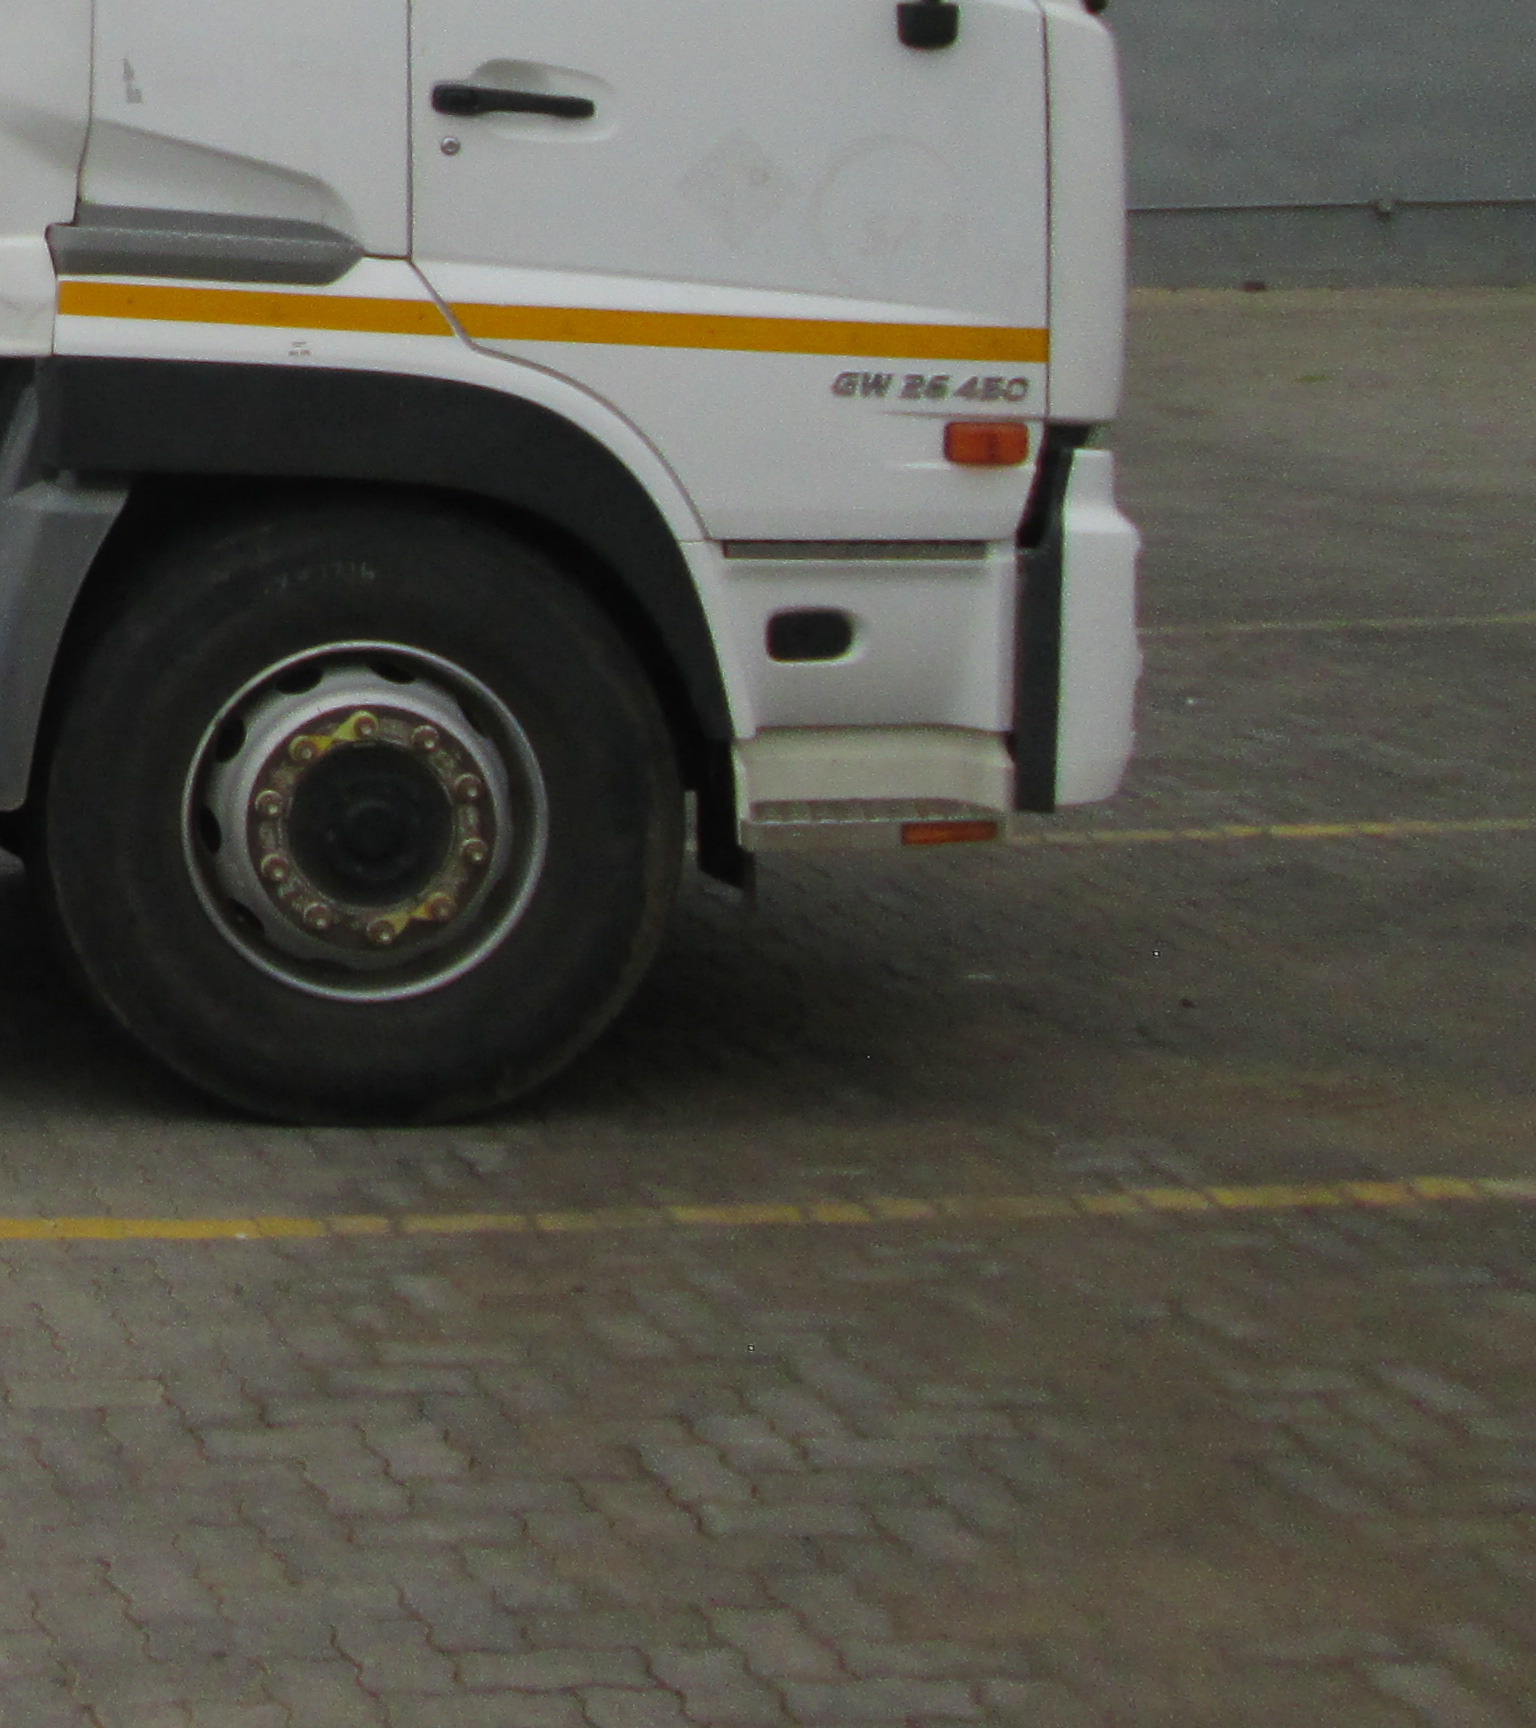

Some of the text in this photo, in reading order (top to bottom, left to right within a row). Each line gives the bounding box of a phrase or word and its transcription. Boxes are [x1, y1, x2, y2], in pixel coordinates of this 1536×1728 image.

[830, 371, 1032, 403] GW 26 450
